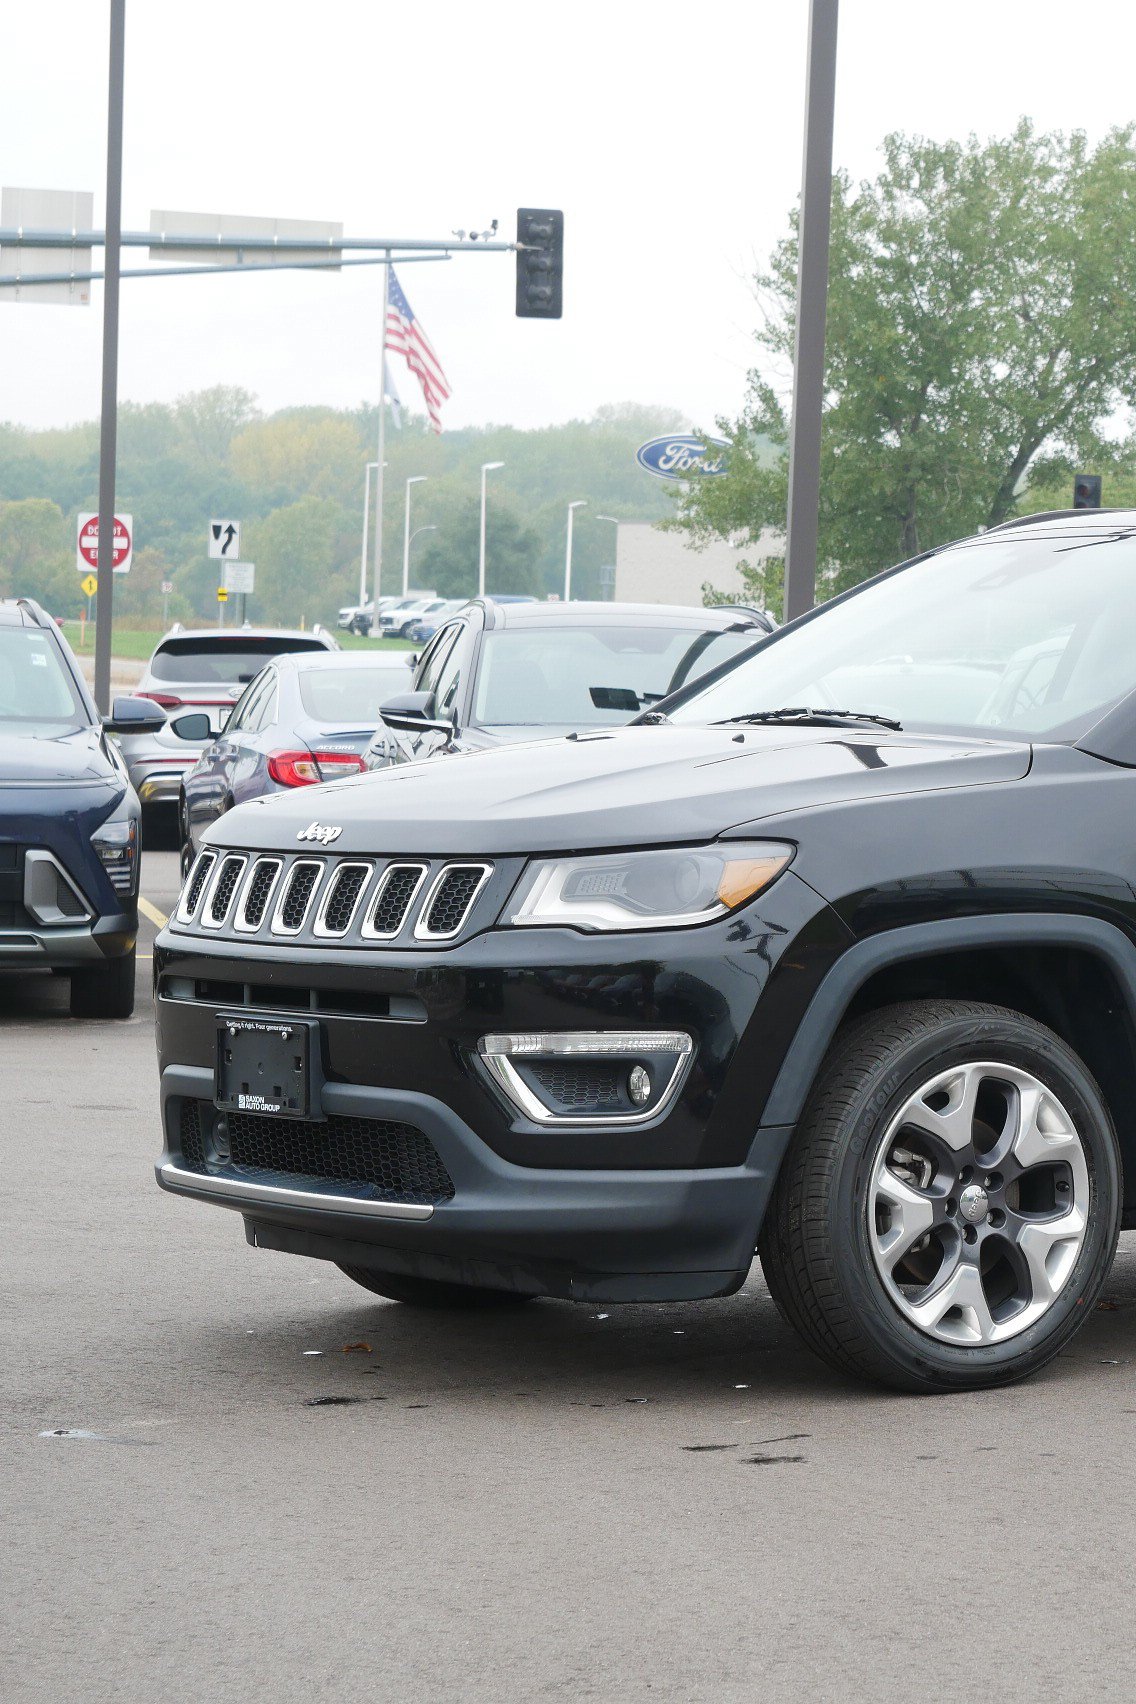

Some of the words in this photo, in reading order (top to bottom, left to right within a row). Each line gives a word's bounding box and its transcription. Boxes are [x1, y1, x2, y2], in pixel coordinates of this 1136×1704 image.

[658, 443, 724, 472] Ford
[296, 821, 343, 846] Jeep
[245, 1095, 265, 1104] SAXON
[245, 1102, 260, 1110] AUTO
[261, 1103, 280, 1112] GROUP
